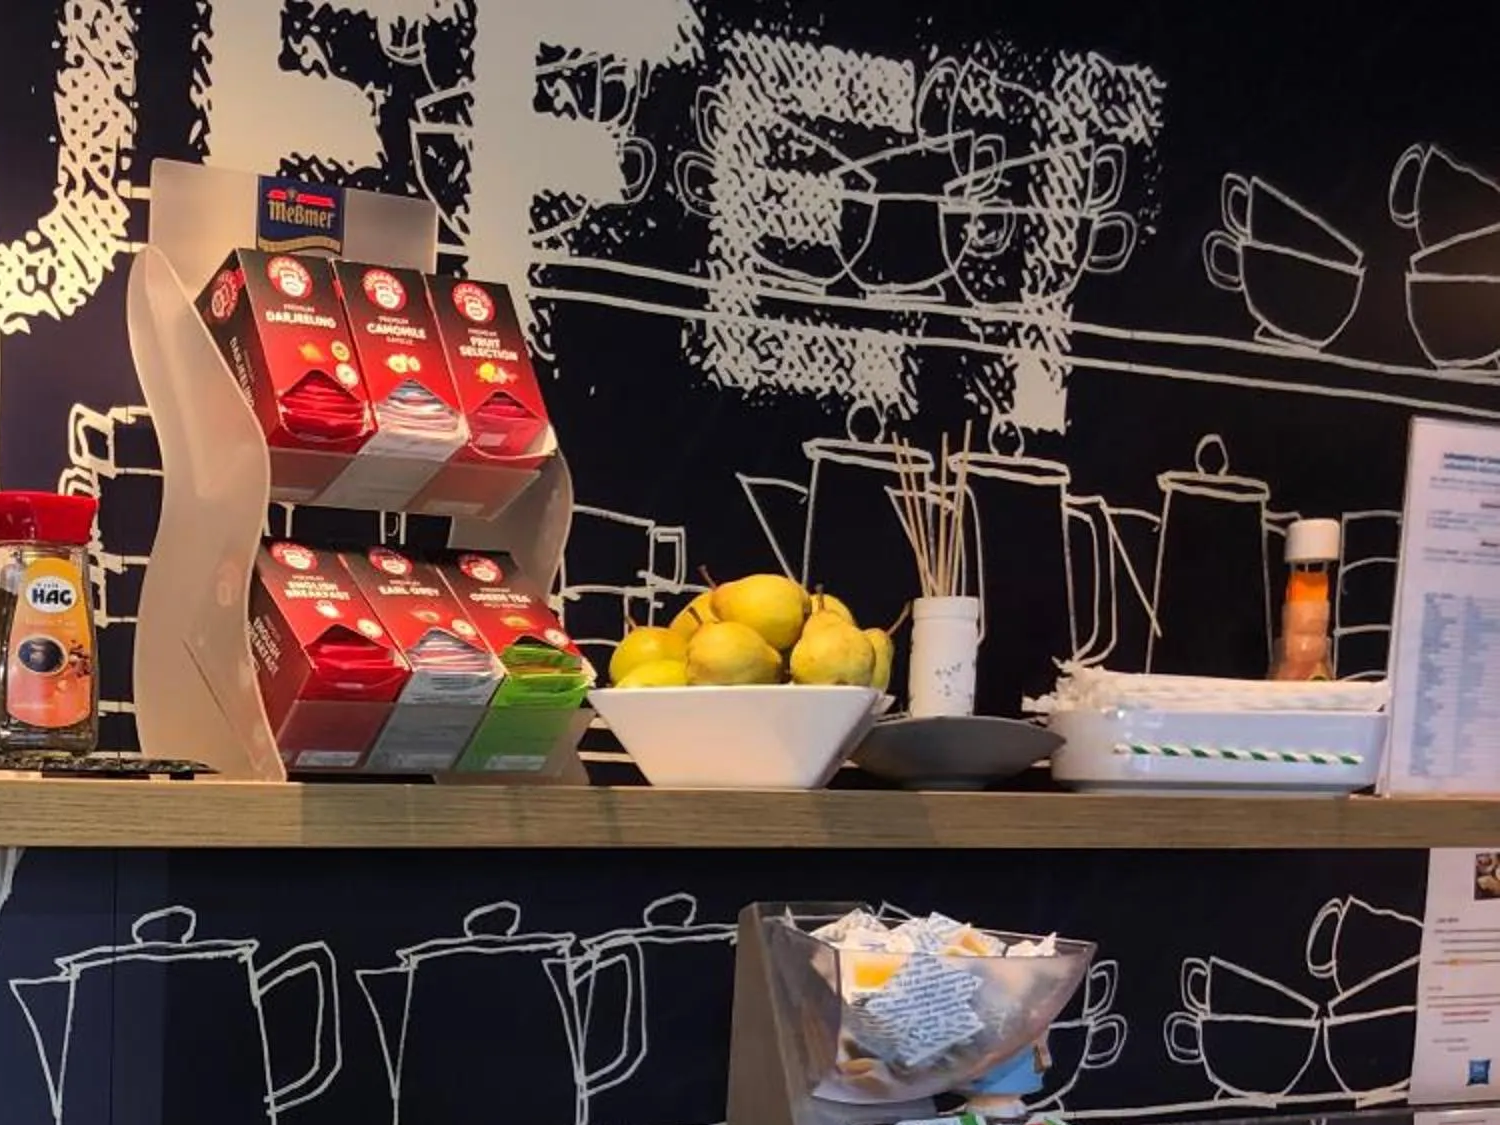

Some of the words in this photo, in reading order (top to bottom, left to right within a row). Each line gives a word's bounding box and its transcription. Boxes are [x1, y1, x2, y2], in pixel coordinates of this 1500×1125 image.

[268, 199, 335, 230] Meßmer
[265, 310, 337, 329] DARJEELING
[366, 323, 427, 340] CAMOMILE
[469, 336, 501, 348] FRUIT
[459, 345, 518, 361] SELECTION
[31, 589, 72, 605] HAG
